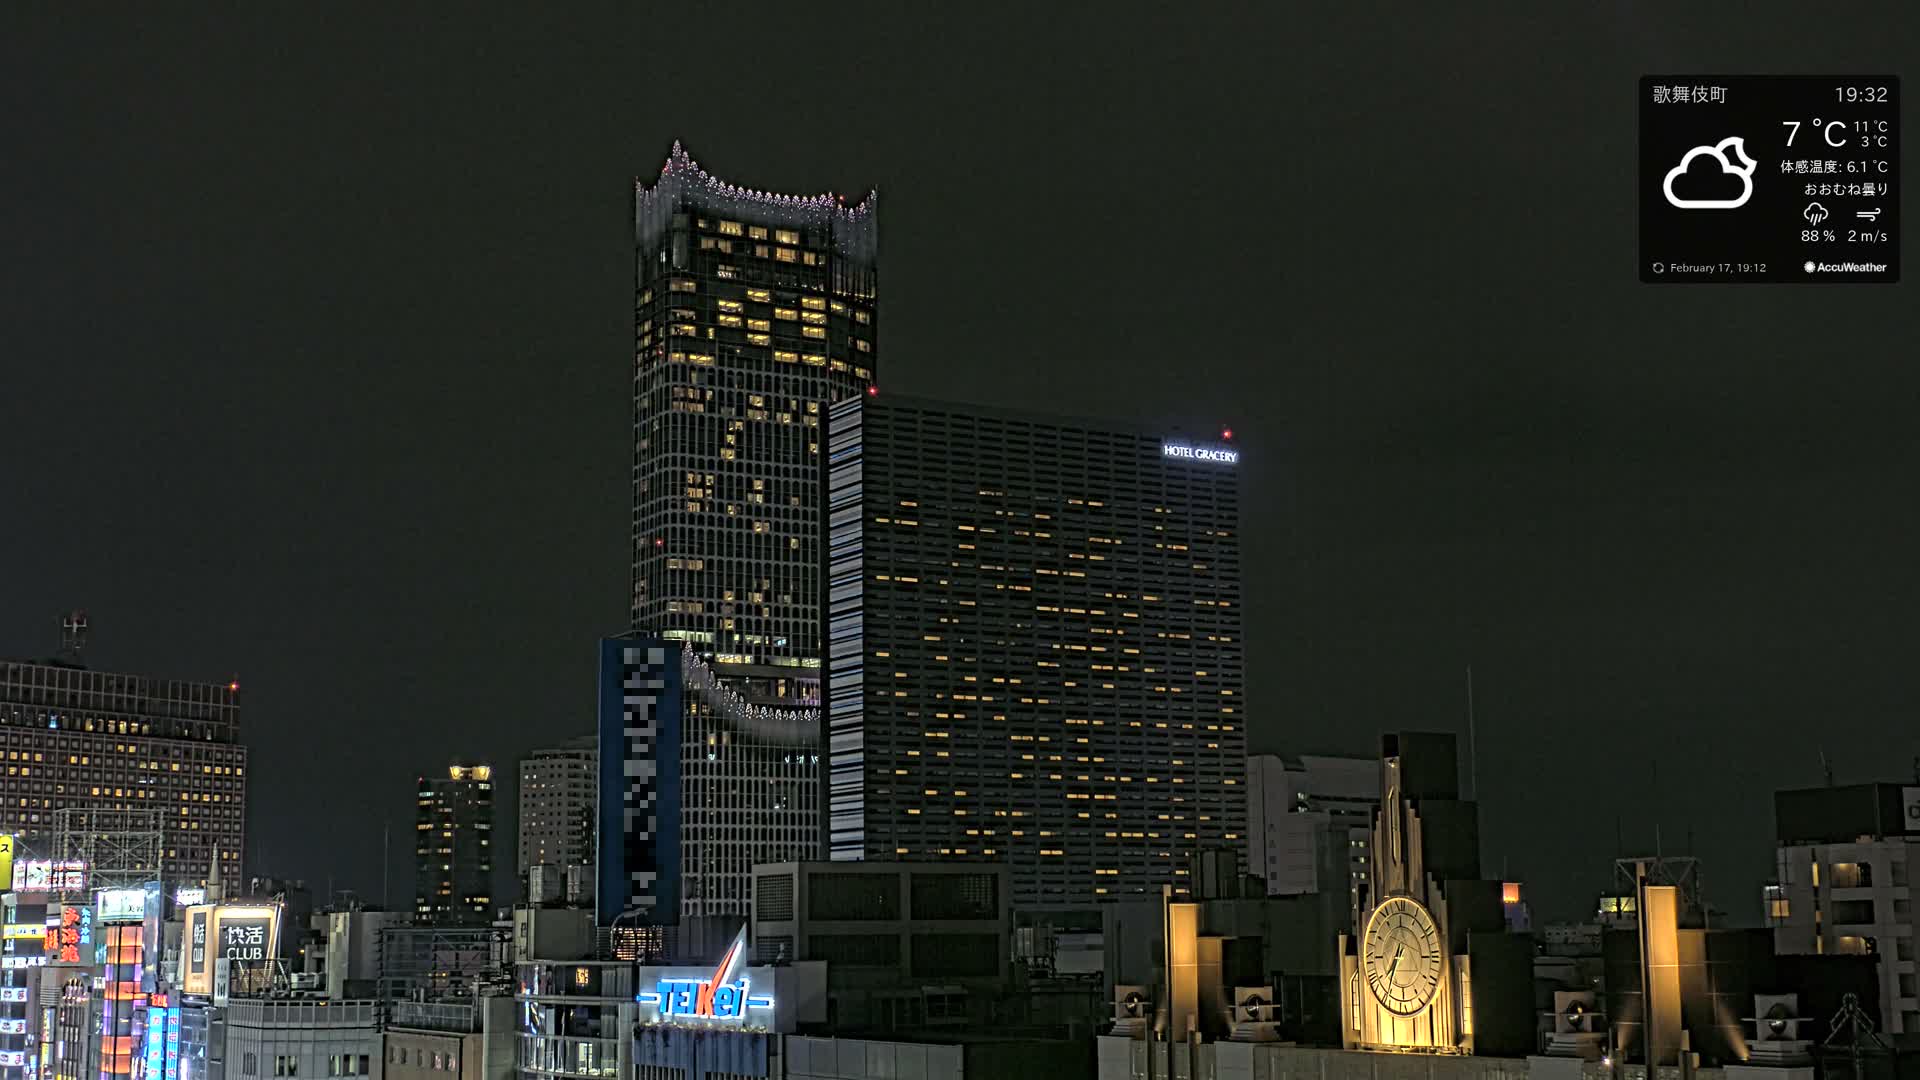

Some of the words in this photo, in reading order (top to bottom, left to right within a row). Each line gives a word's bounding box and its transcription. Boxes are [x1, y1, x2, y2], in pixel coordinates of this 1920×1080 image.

[1164, 445, 1194, 458] HOTEL
[1194, 448, 1237, 463] GRACERY
[226, 926, 264, 945] 快活
[226, 947, 263, 960] CLUB
